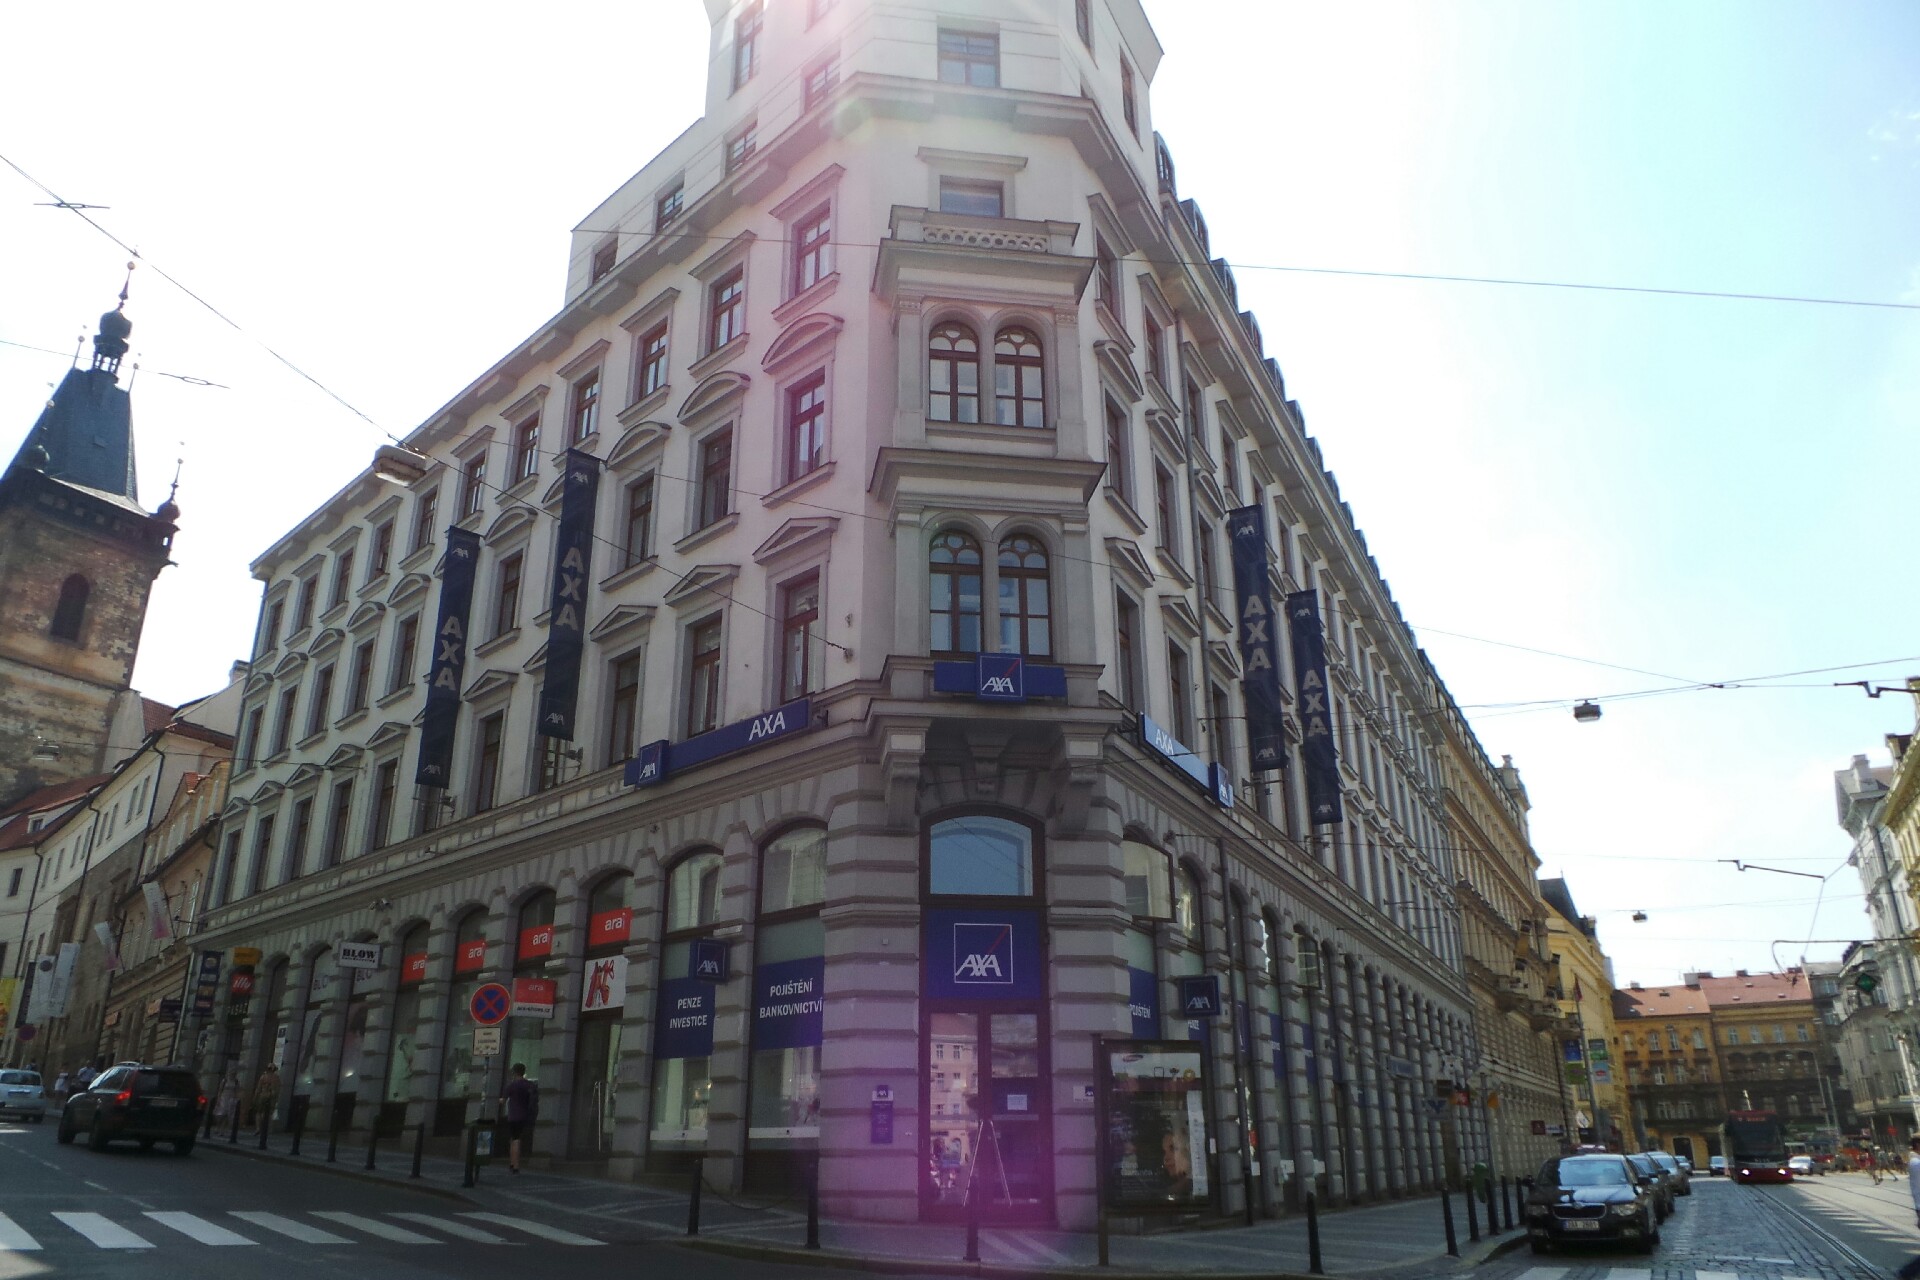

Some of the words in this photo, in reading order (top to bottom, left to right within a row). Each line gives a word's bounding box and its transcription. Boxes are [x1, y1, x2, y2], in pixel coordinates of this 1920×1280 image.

[555, 546, 585, 632] AXA
[1243, 595, 1272, 672] AXA
[434, 615, 463, 692] AXA
[981, 676, 1015, 693] AXA
[1302, 669, 1329, 738] AXA
[749, 711, 786, 742] AXA
[1155, 728, 1174, 756] AXA
[639, 762, 656, 779] AXA
[343, 949, 376, 959] BLOW
[697, 959, 719, 974] AXA
[955, 954, 1003, 977] AXA
[677, 996, 702, 1010] PENZE
[759, 997, 824, 1019] BANKOVNICTVÍ
[1187, 996, 1211, 1009] AXA
[669, 1014, 708, 1029] INVESTICE
